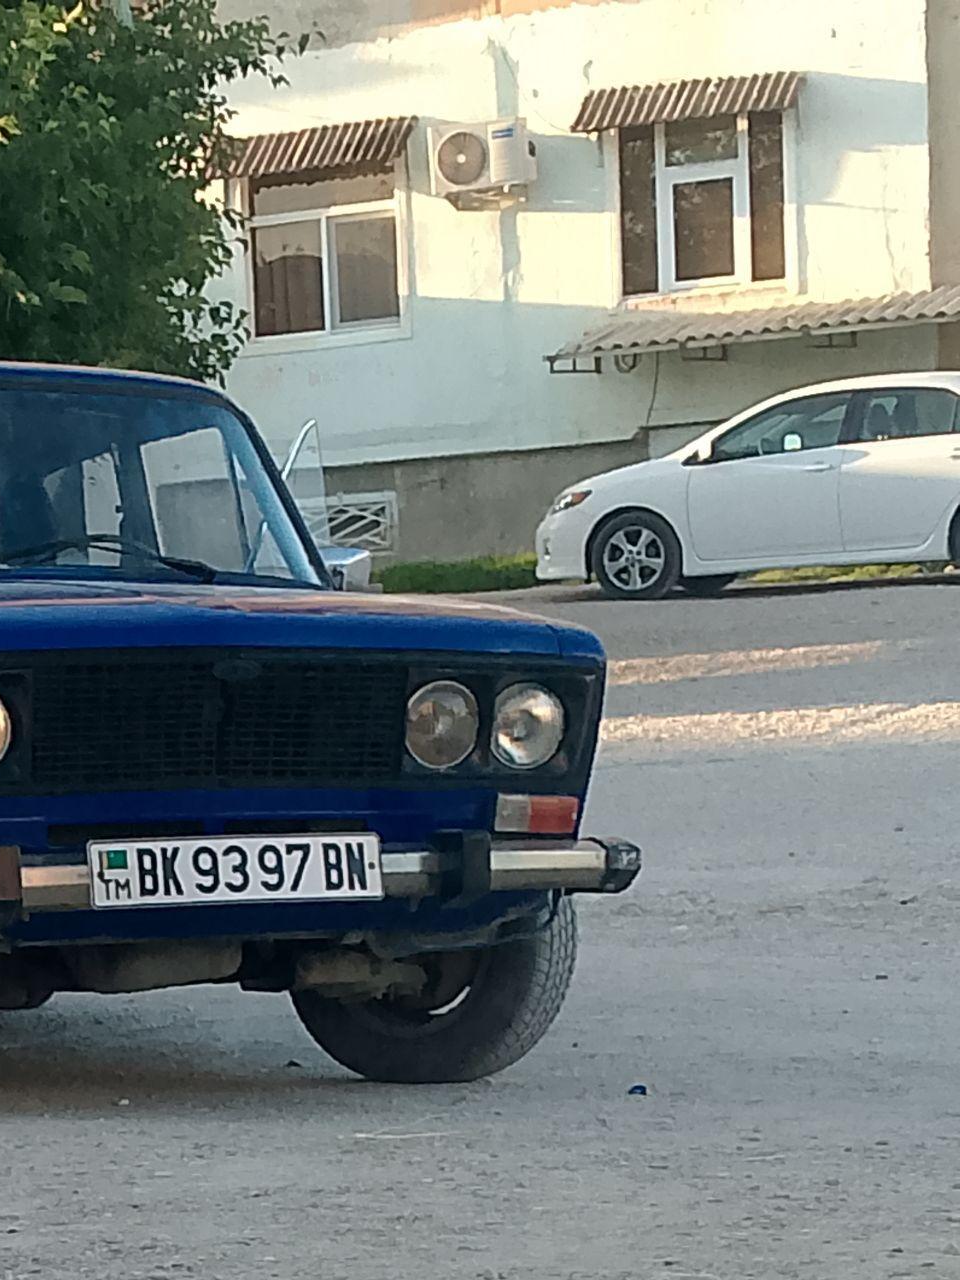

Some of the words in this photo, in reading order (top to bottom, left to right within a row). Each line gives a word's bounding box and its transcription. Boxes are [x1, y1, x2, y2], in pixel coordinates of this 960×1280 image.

[137, 847, 184, 896] BK
[192, 844, 311, 893] 9397
[322, 843, 368, 891] BN
